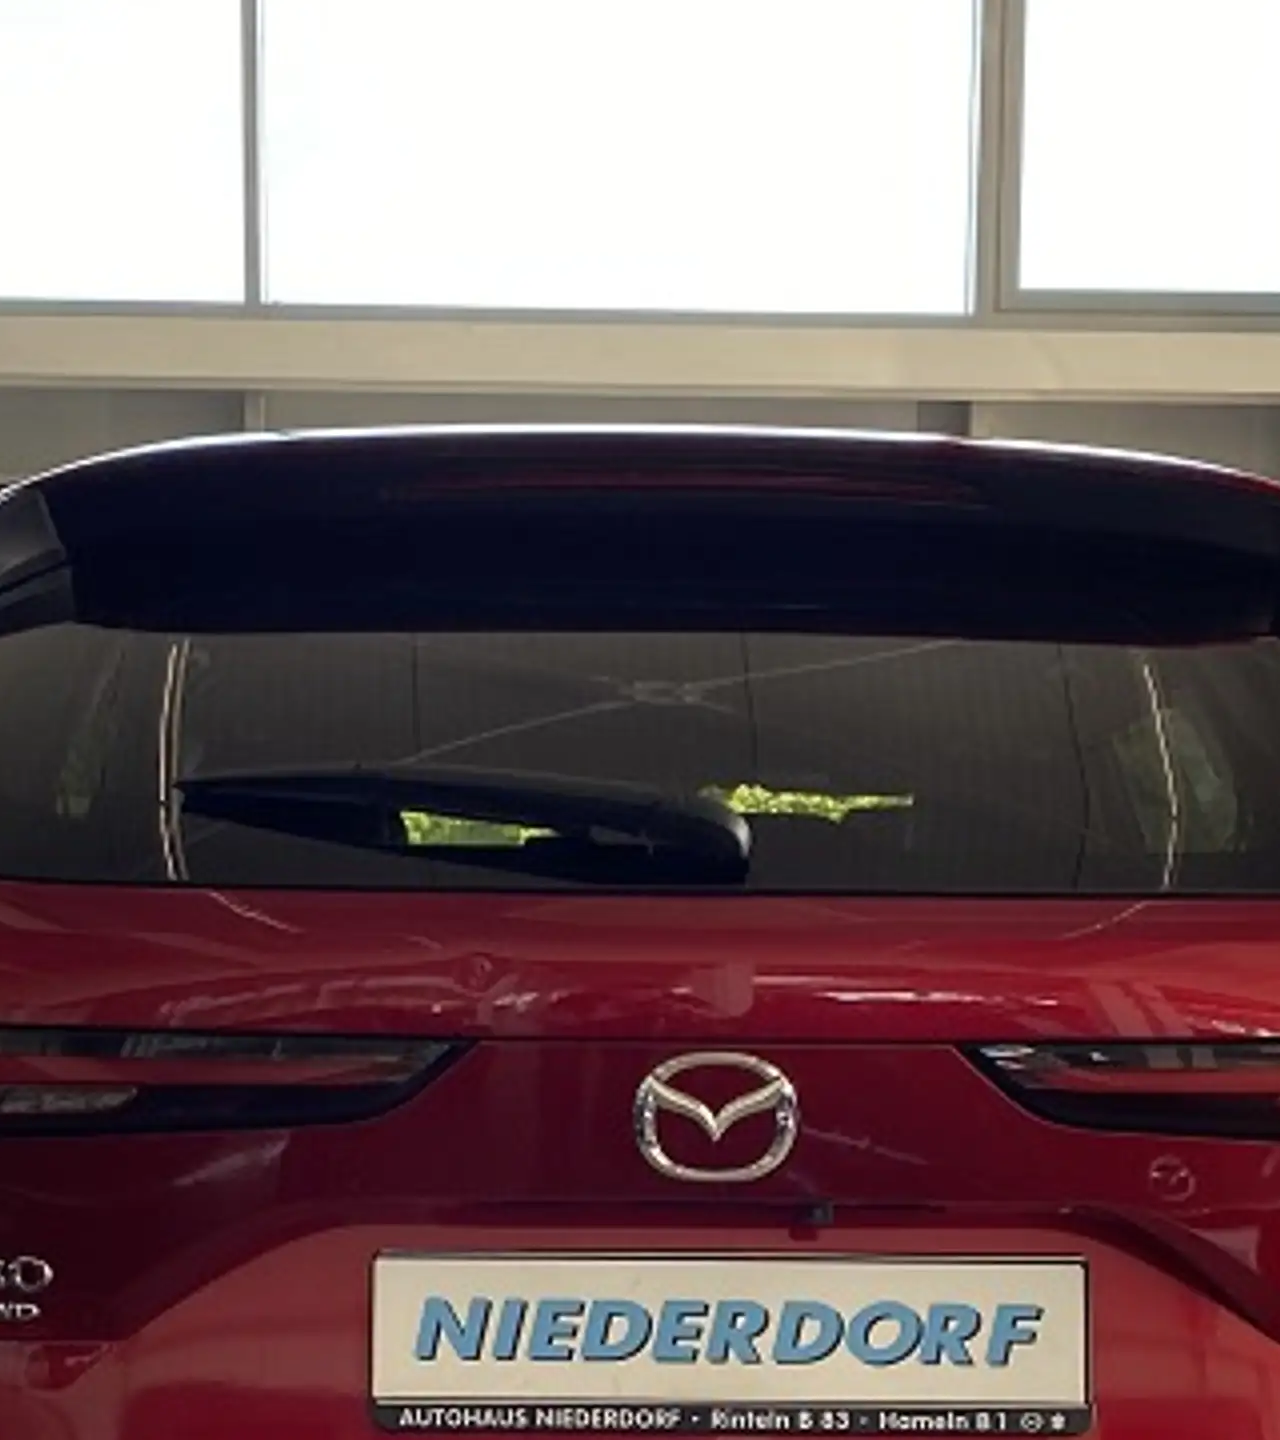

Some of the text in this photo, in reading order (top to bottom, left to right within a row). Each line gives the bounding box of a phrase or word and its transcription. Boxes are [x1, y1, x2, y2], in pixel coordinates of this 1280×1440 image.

[415, 1296, 1045, 1367] NIEDERDORF
[399, 1407, 527, 1429] AUTOHAUS
[535, 1407, 681, 1430] NIEDERDORF
[879, 1411, 969, 1430] Hameln
